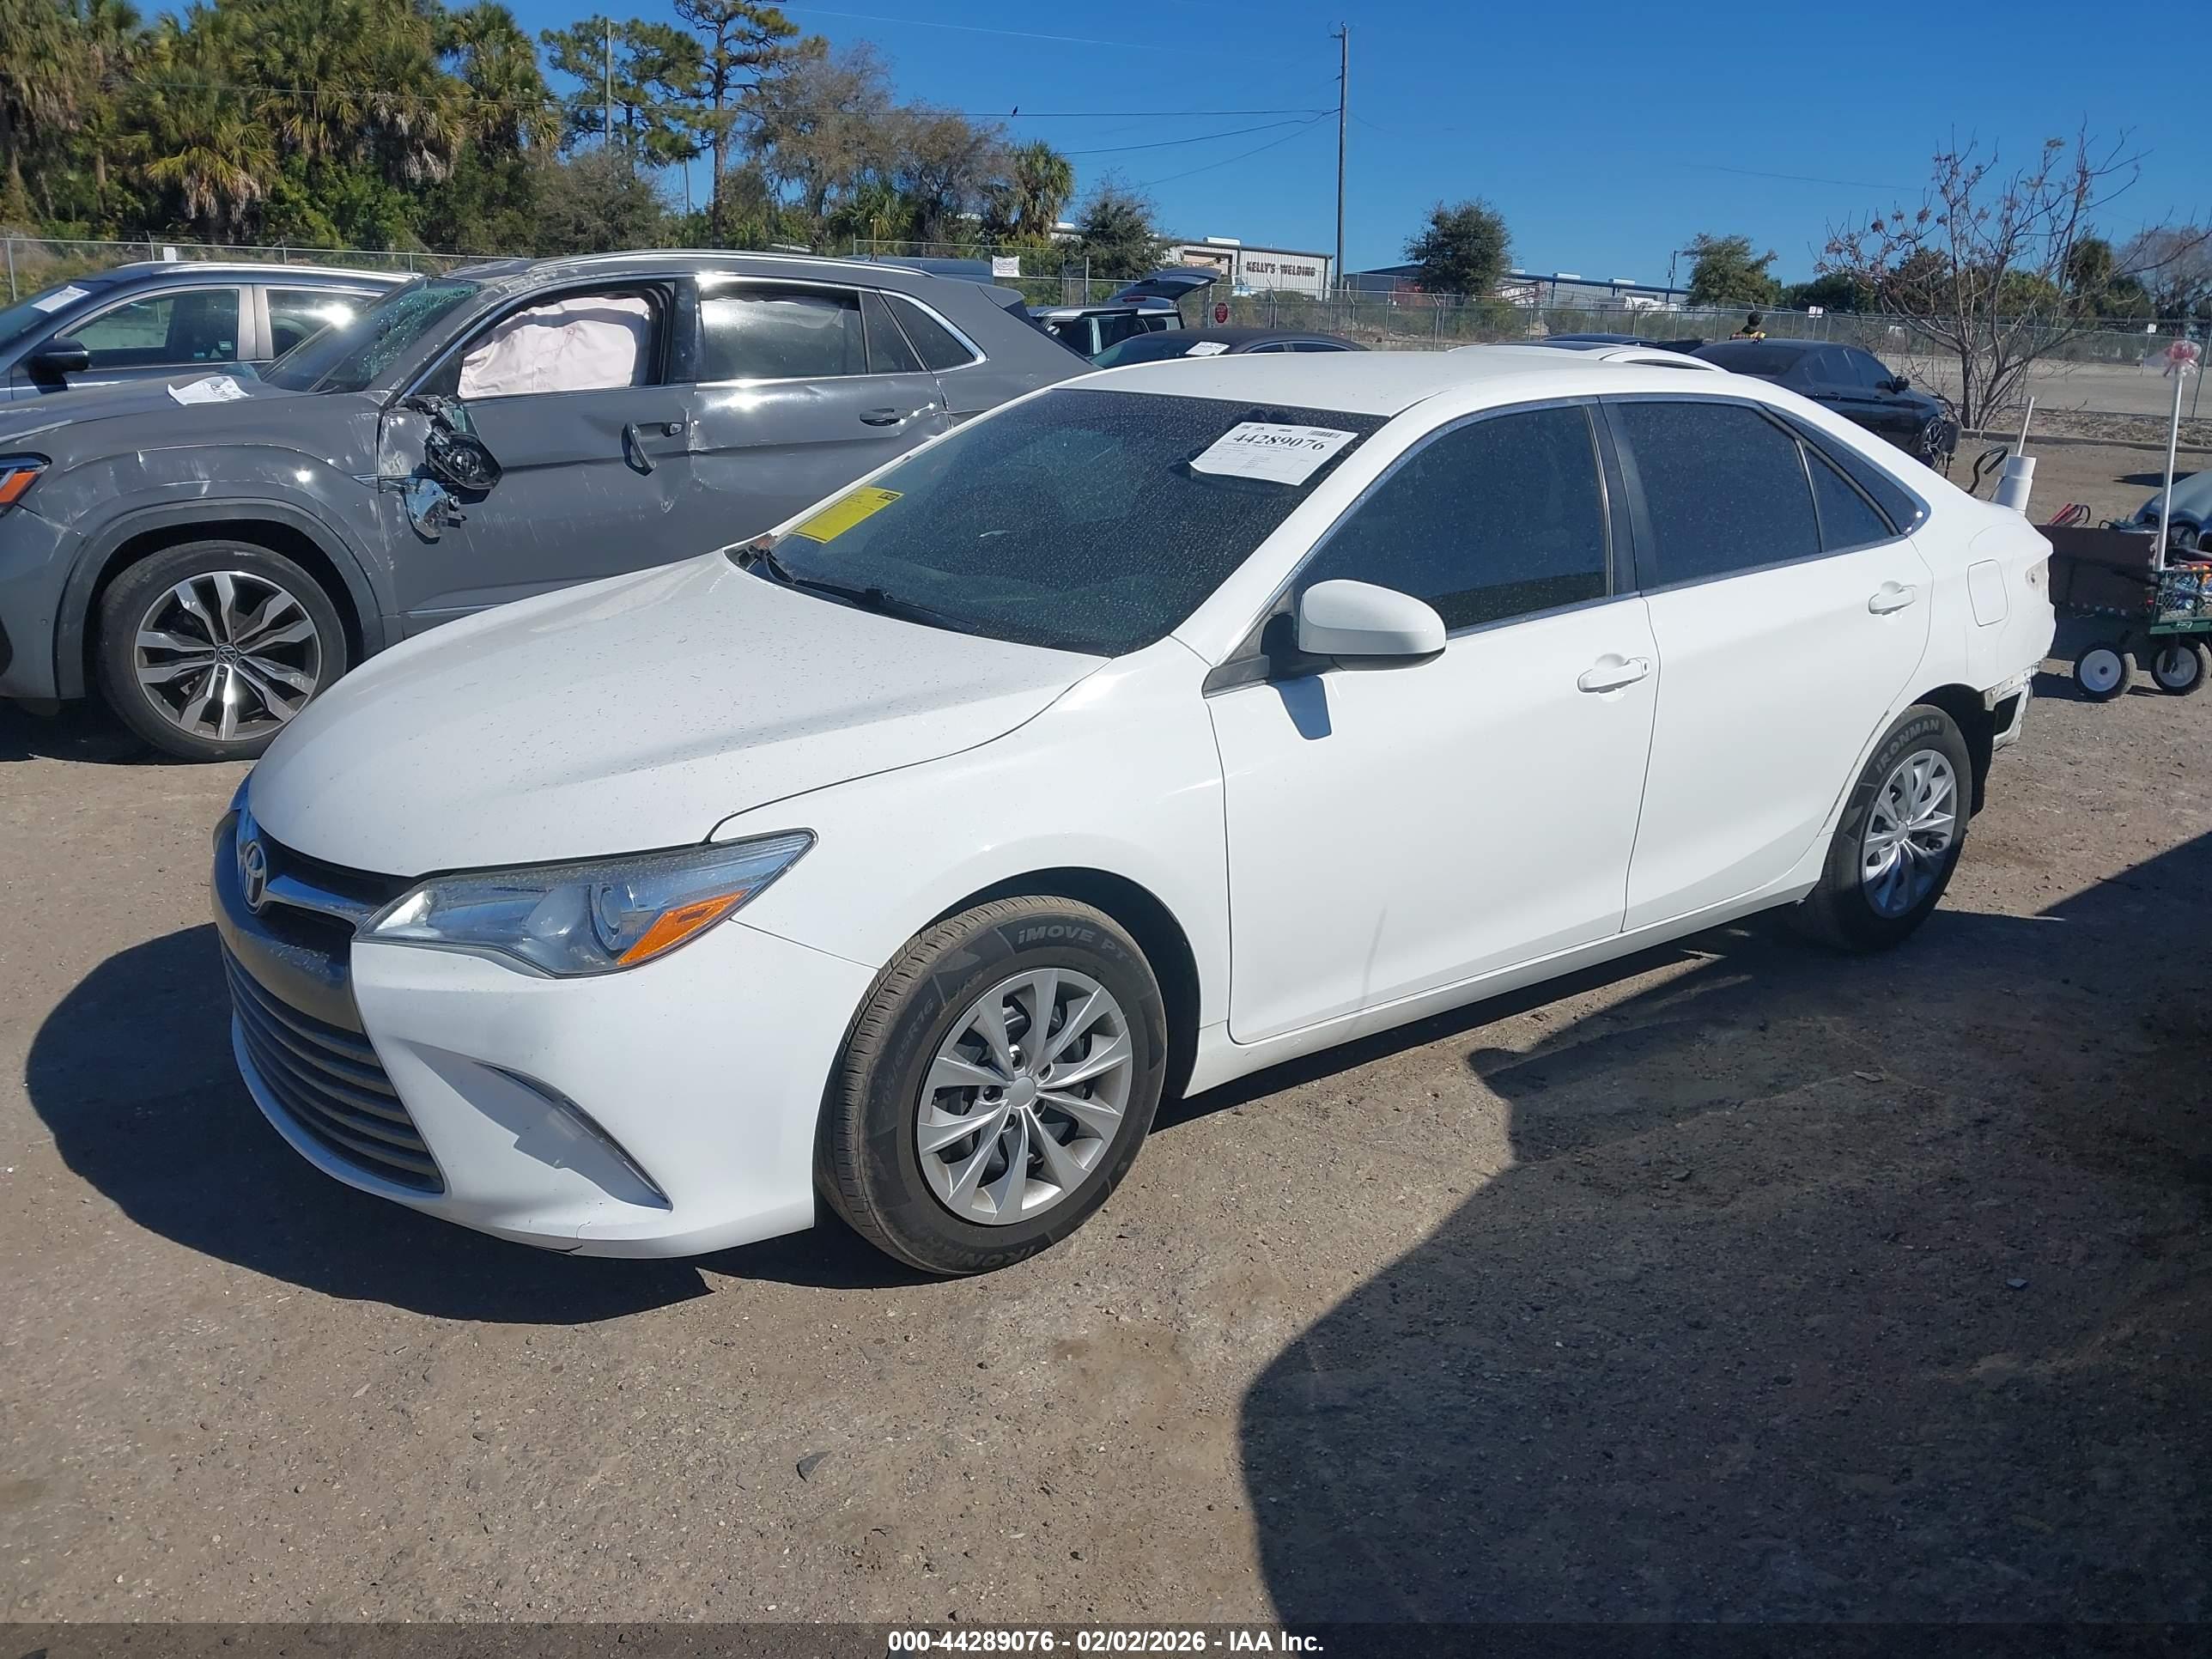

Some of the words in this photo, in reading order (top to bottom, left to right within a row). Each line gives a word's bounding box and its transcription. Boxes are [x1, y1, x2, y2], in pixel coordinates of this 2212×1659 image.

[1246, 261, 1276, 275] KELLY'S
[1279, 263, 1316, 277] WELDING
[1233, 433, 1331, 451] 44289076
[1875, 720, 1939, 774] IRONMAN
[1018, 925, 1097, 945] iMOVE
